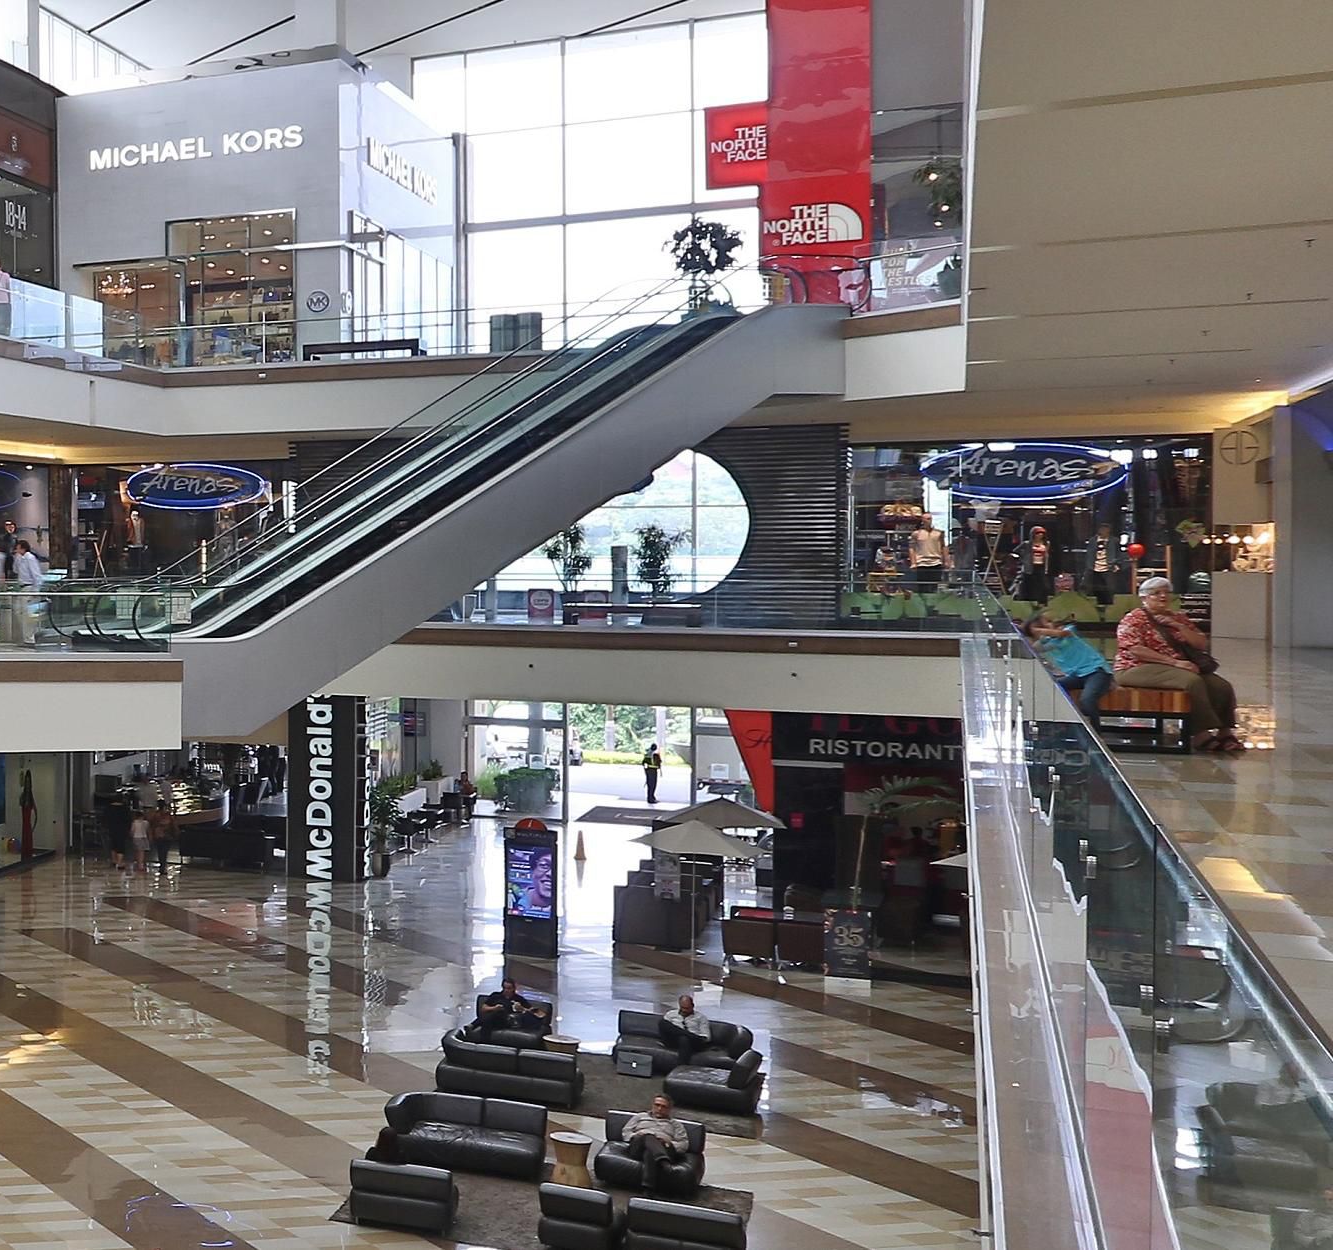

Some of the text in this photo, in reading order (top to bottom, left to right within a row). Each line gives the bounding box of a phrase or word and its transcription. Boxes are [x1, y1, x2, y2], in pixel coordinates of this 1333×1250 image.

[735, 125, 767, 139] THE
[89, 124, 304, 172] MICHAEL KORS
[710, 136, 767, 154] NORTH
[726, 149, 768, 163] FACE
[790, 204, 827, 219] THE
[763, 216, 827, 234] NORTH
[782, 230, 827, 246] FACE
[938, 446, 1096, 490] Arenas
[141, 467, 241, 495] Arenas
[834, 926, 865, 947] 35
